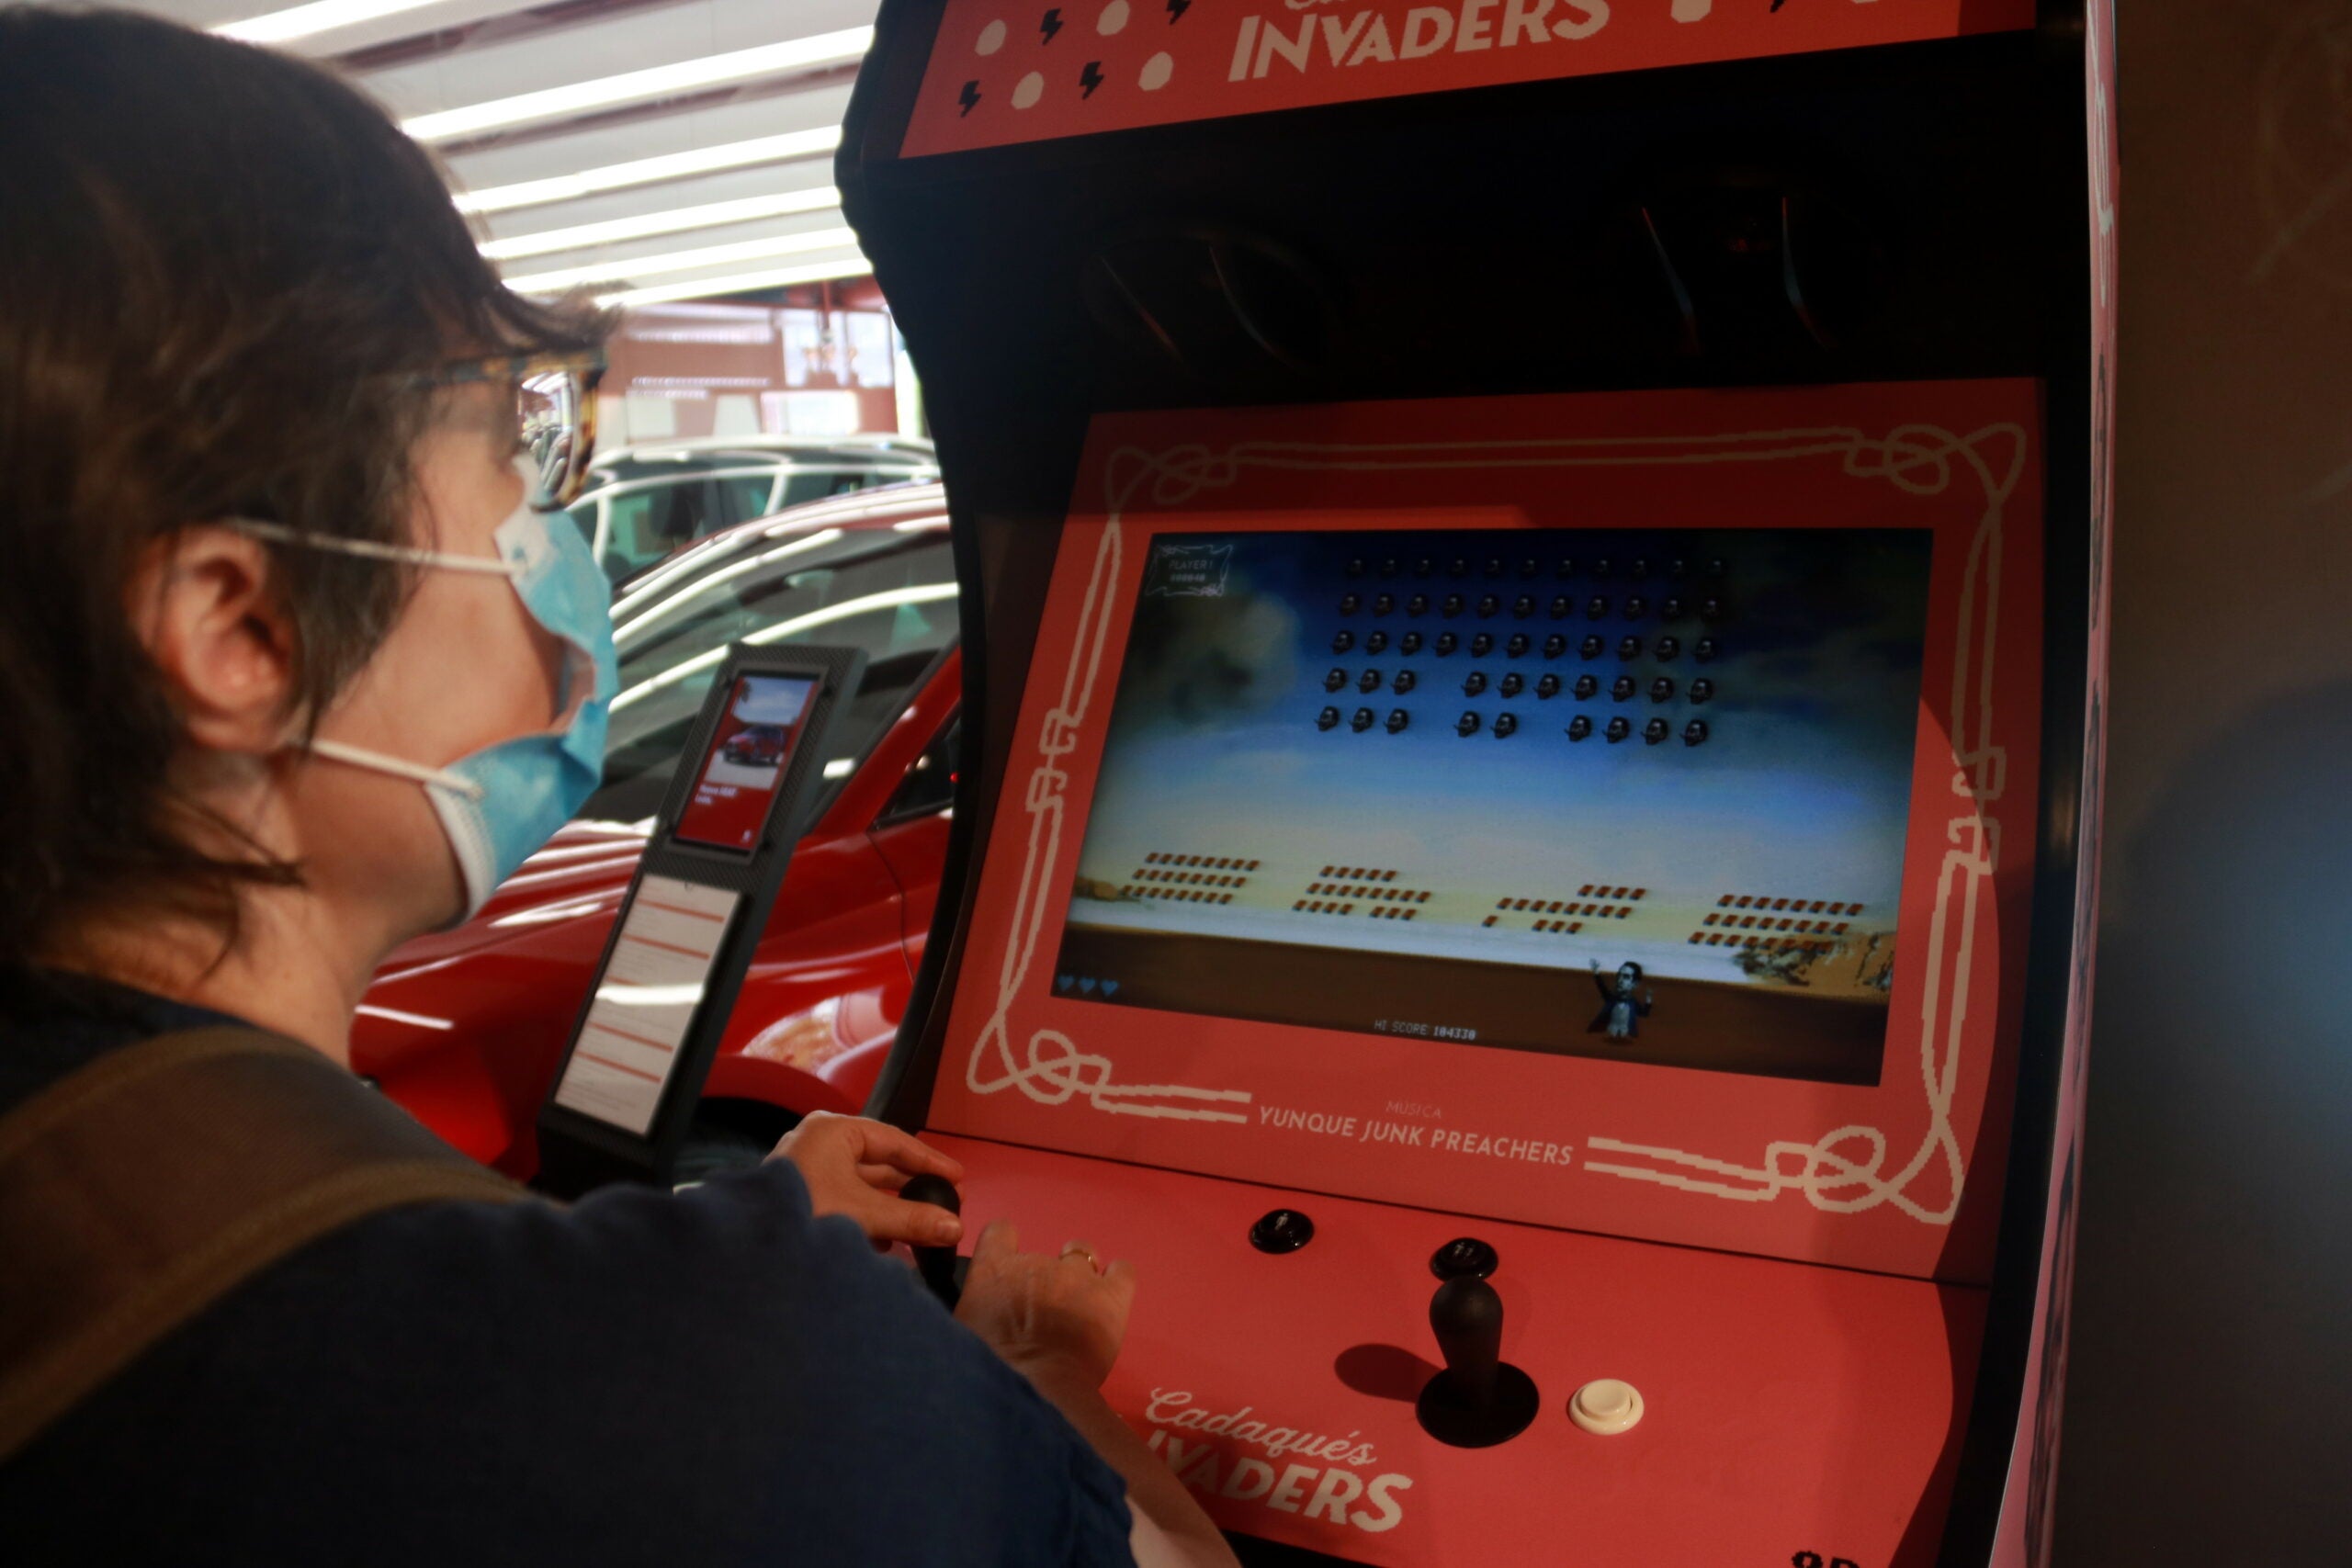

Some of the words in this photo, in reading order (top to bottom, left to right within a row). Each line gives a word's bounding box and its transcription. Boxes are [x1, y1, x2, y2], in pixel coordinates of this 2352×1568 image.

[1227, 0, 1610, 82] INVADERS
[1169, 559, 1206, 570] PLAYER
[1374, 1020, 1386, 1031] HI
[1392, 1021, 1428, 1035] SCORE
[1259, 1106, 1357, 1137] YUNQUE
[1360, 1122, 1424, 1147] JUNK
[1430, 1130, 1574, 1166] PREACHERS
[1145, 1388, 1377, 1467] Cadaqués
